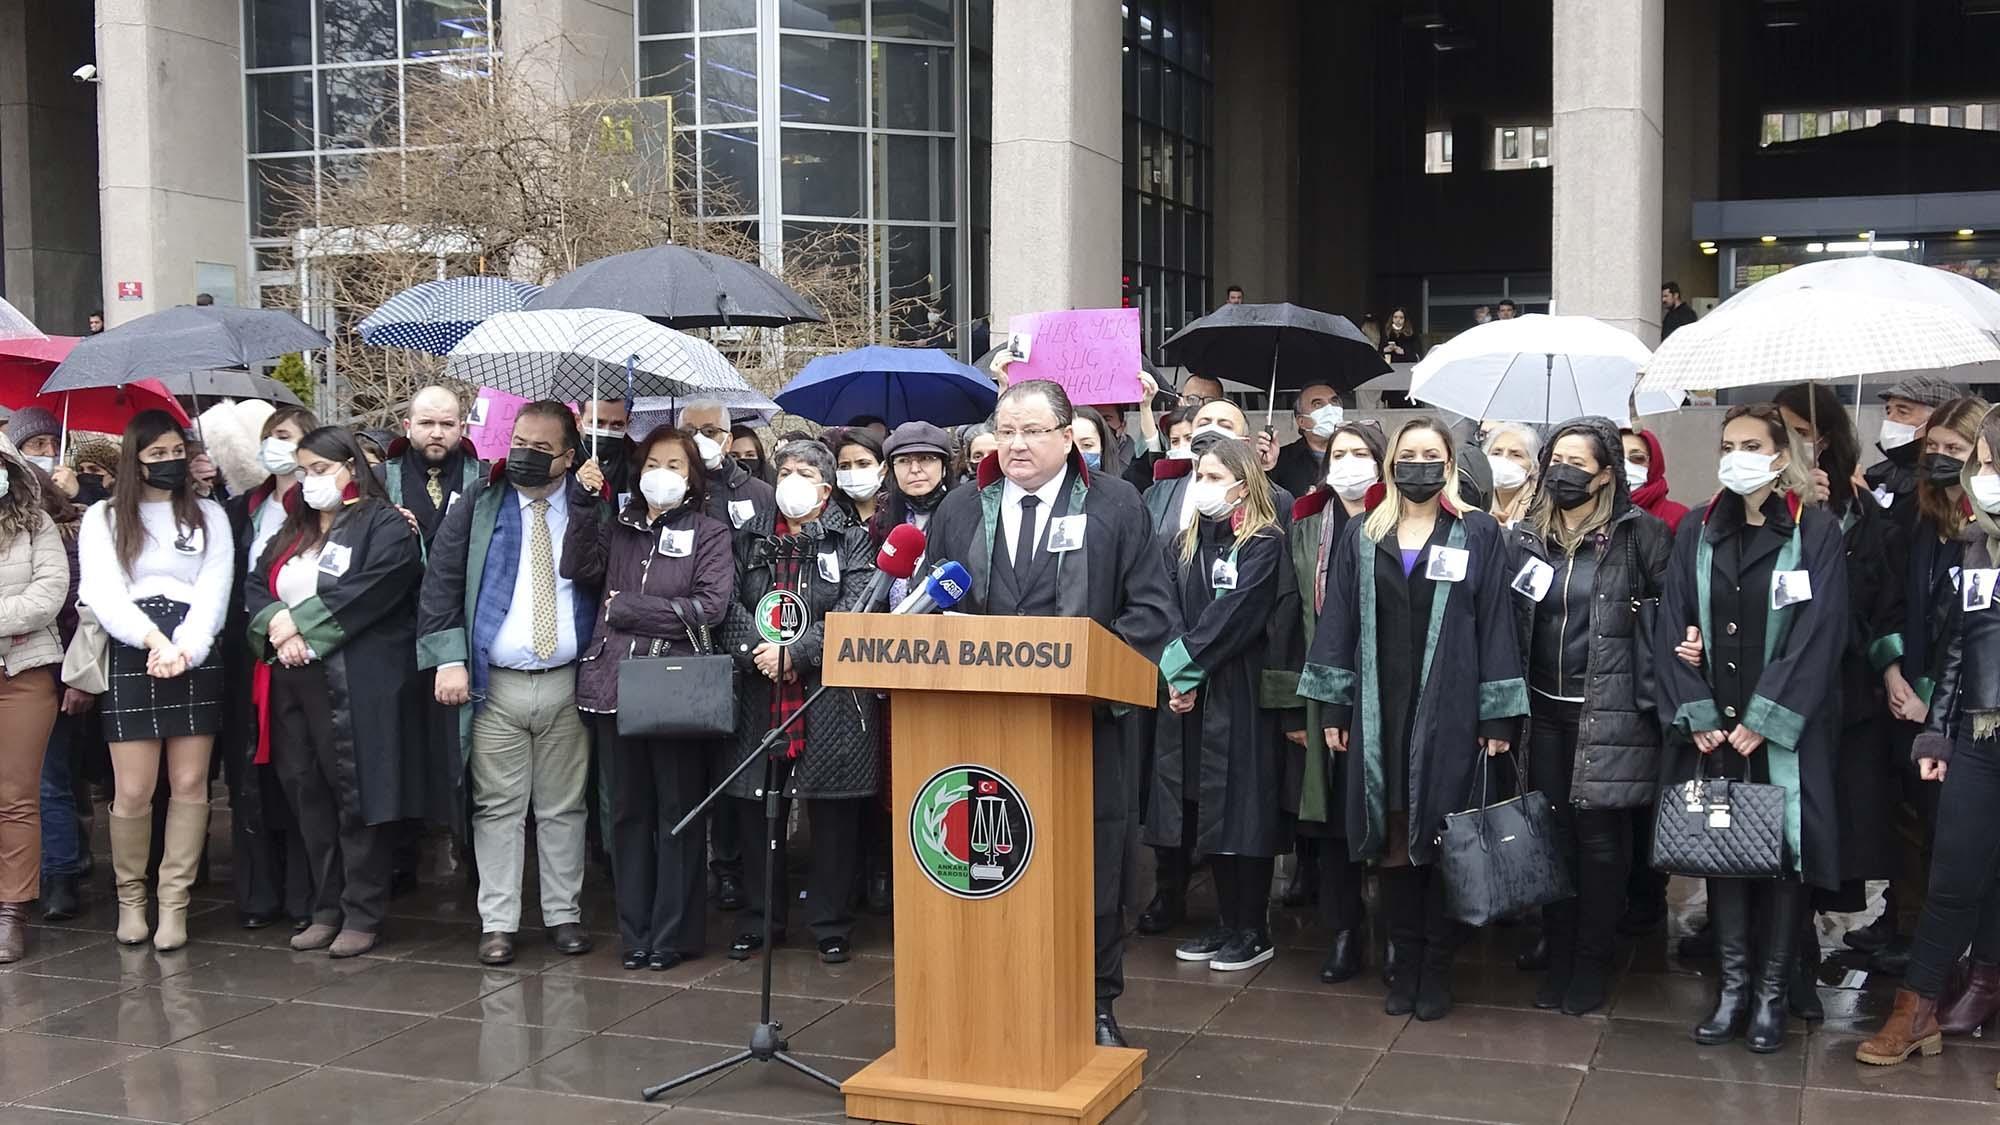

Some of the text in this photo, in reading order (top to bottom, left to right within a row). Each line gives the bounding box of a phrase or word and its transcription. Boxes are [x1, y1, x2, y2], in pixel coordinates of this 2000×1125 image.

[1035, 319, 1078, 344] HER
[837, 638, 1073, 668] ANKARA BAROSU
[938, 863, 968, 871] ANKARA
[938, 870, 968, 878] BAROSU
